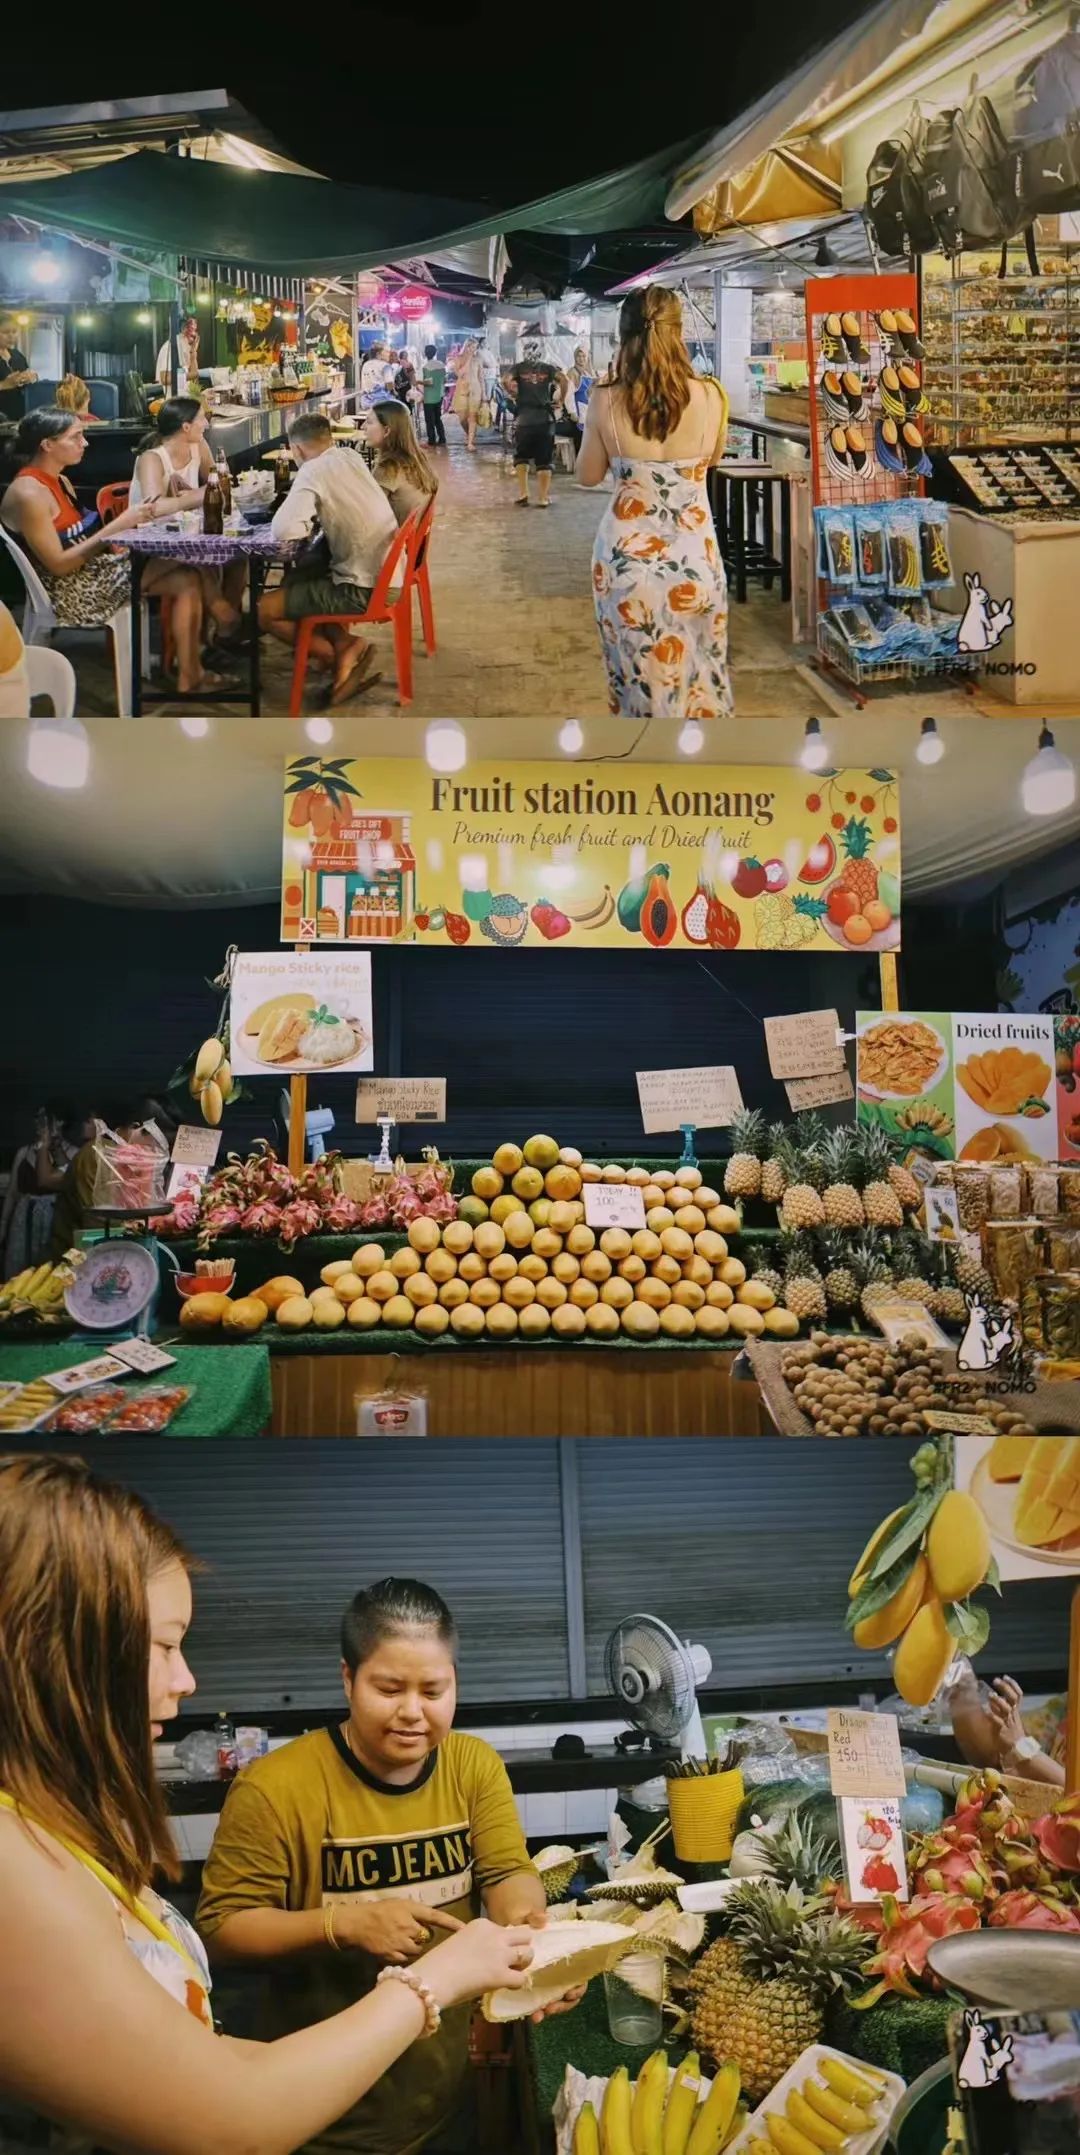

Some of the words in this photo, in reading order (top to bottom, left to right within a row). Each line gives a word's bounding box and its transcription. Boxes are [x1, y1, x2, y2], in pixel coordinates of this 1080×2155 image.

[431, 777, 516, 813] Fruit
[524, 779, 638, 815] station
[646, 783, 775, 826] Aonang
[453, 821, 525, 844] Premium
[530, 823, 573, 851] fresh
[577, 824, 618, 851] fruit
[622, 825, 657, 847] and
[661, 825, 710, 848] Dried
[239, 962, 286, 976] Mango
[288, 962, 330, 975] Sticky
[334, 963, 361, 974] rice
[957, 1023, 1001, 1039] Dried
[1006, 1024, 1050, 1039] fruits
[833, 1731, 851, 1745] Red
[837, 1748, 858, 1762] 150
[327, 1848, 380, 1887] MC
